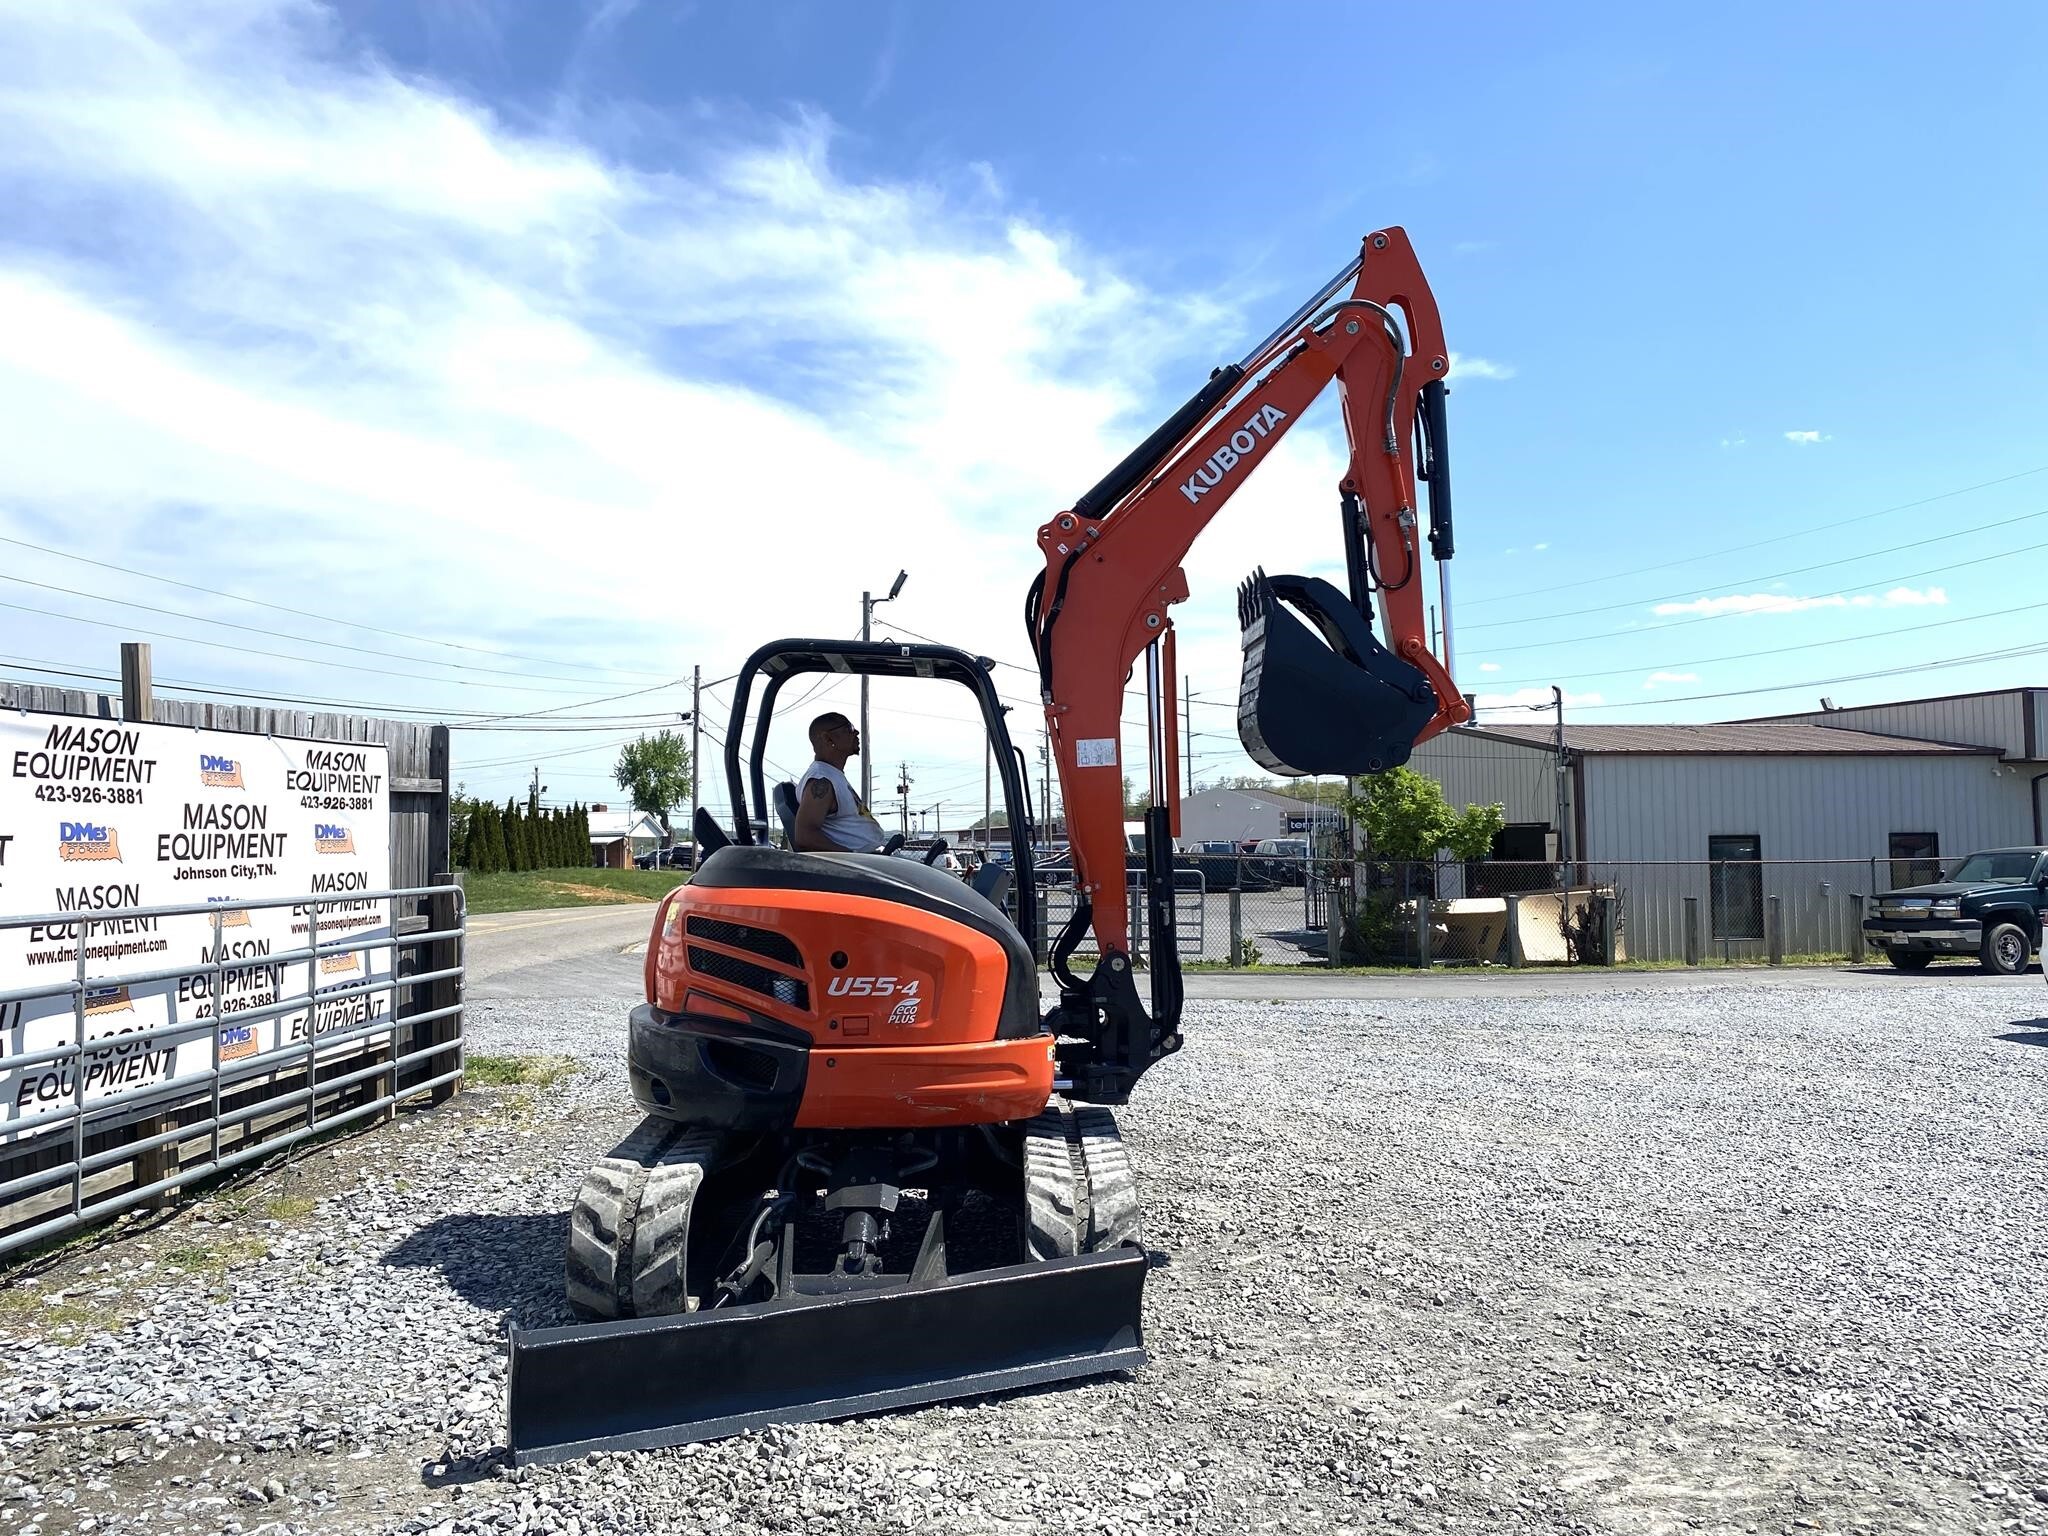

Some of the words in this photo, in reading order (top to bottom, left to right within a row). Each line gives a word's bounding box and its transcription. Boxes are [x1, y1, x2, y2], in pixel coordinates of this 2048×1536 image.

[1179, 403, 1288, 504] KUBOTA
[45, 724, 140, 756] MASON
[13, 751, 157, 784] EQUIPMENT
[306, 749, 366, 773] MASON
[286, 769, 381, 794] EQUIPMENT
[35, 784, 143, 805] 423-926-3881
[300, 795, 373, 811] 423-926-3881
[183, 803, 267, 831] MASON
[157, 833, 288, 861] EQUIPMENT
[173, 867, 227, 881] Johnson
[312, 871, 367, 893] MASON
[56, 883, 140, 912] MASON
[291, 915, 382, 934] www.masonequipment.com
[26, 938, 168, 966] www.dmaonequipment.com
[827, 976, 920, 997] U55-4
[195, 990, 278, 1019] 42-926-3881
[896, 1006, 918, 1015] eco
[888, 1015, 916, 1024] PLUS
